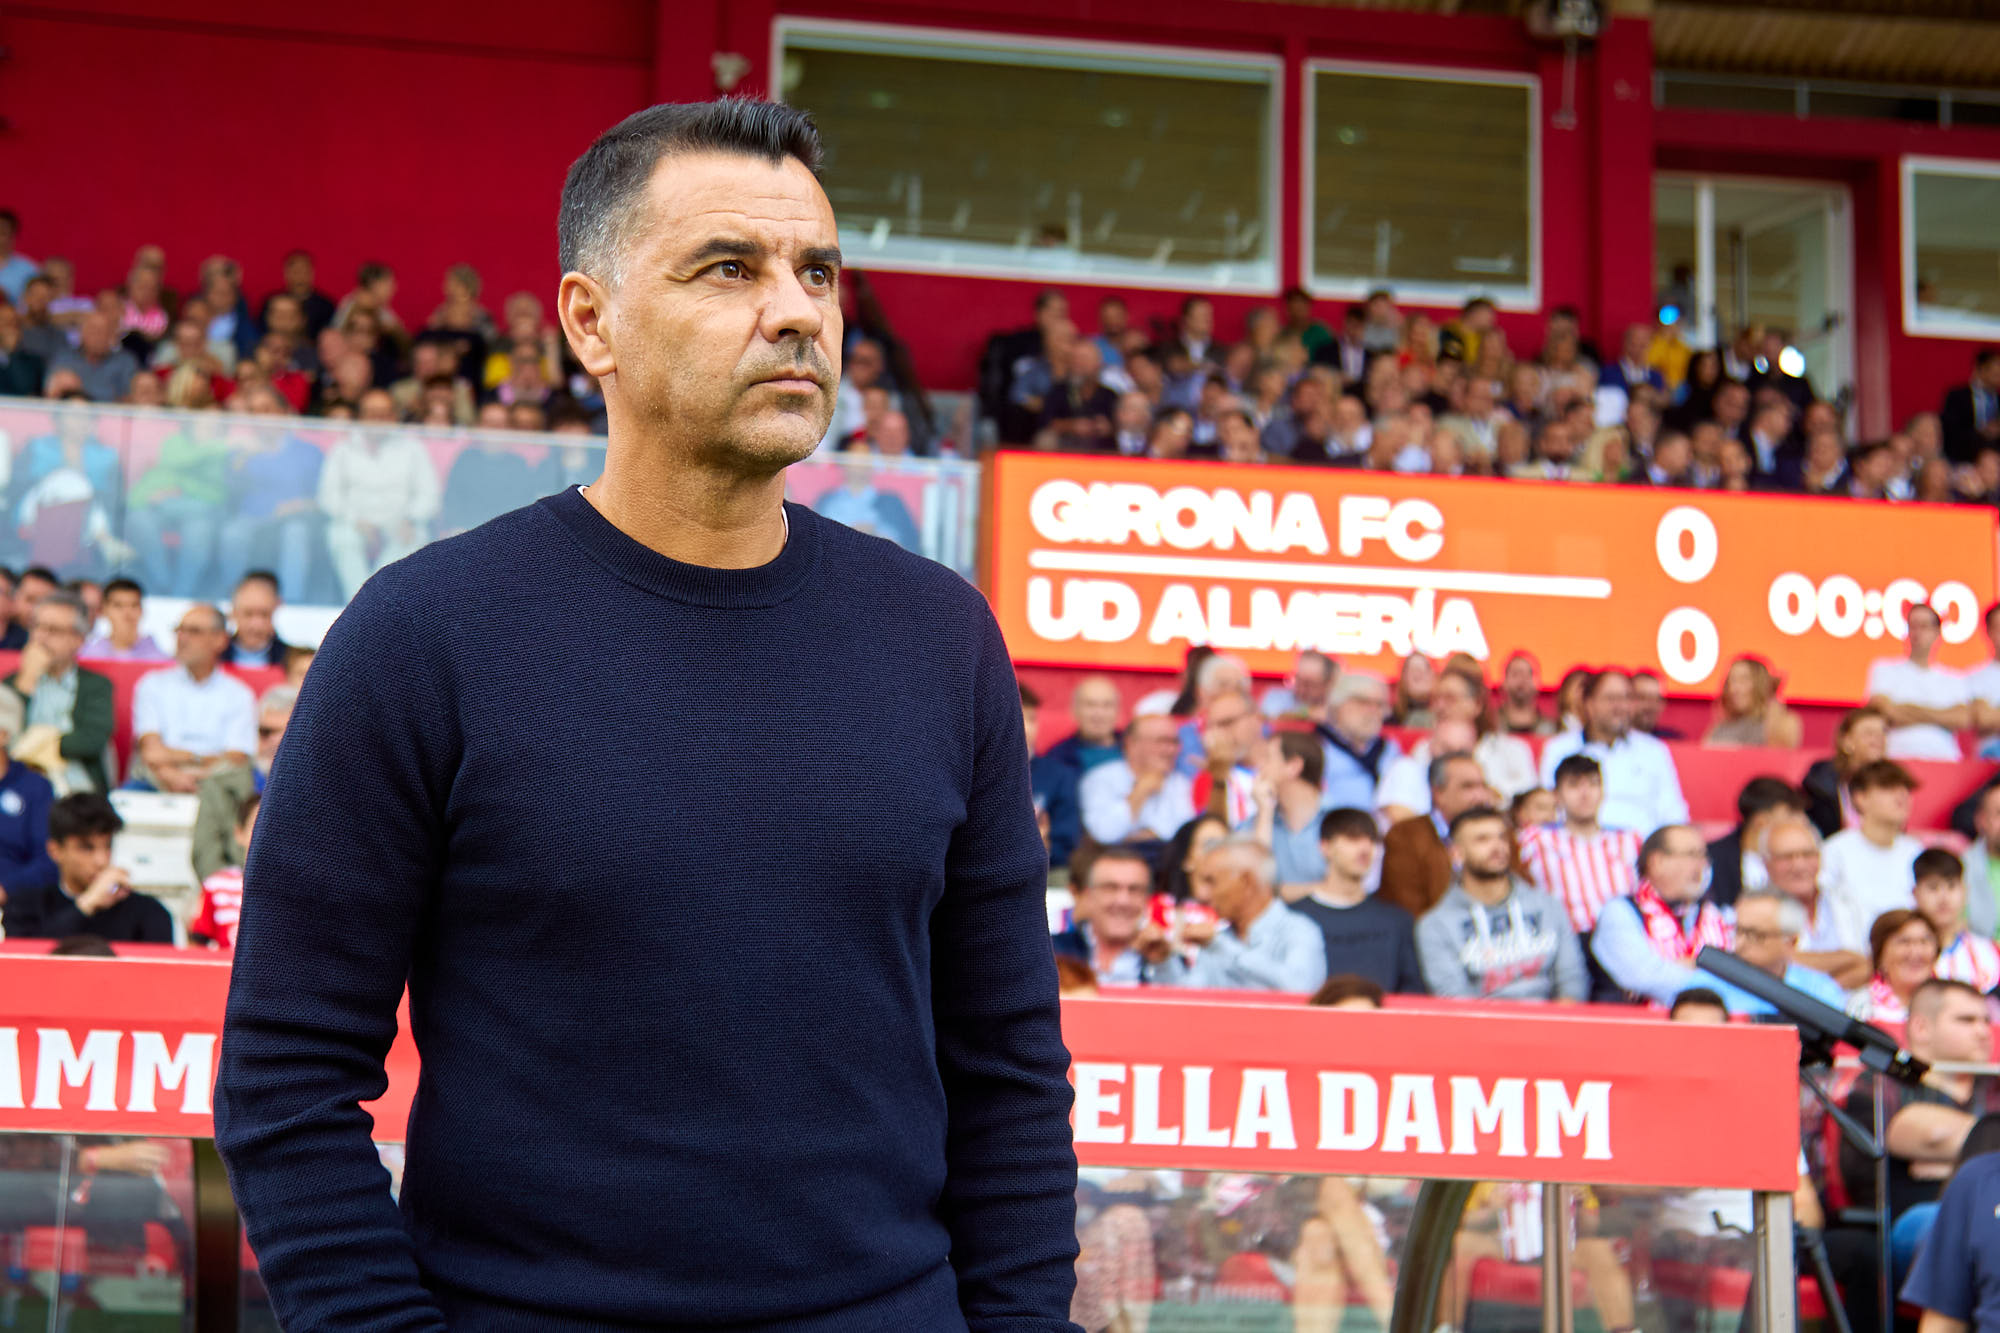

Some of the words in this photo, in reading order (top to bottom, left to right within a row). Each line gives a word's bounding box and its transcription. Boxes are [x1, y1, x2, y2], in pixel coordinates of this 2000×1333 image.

[1030, 480, 1329, 555] GIRONA
[1339, 495, 1444, 562] FC
[1656, 506, 1718, 583] 0
[1027, 577, 1141, 642] UD
[1148, 584, 1489, 660] ALMERÍA
[1657, 607, 1719, 684] 0
[1316, 1071, 1613, 1161] DAMM
